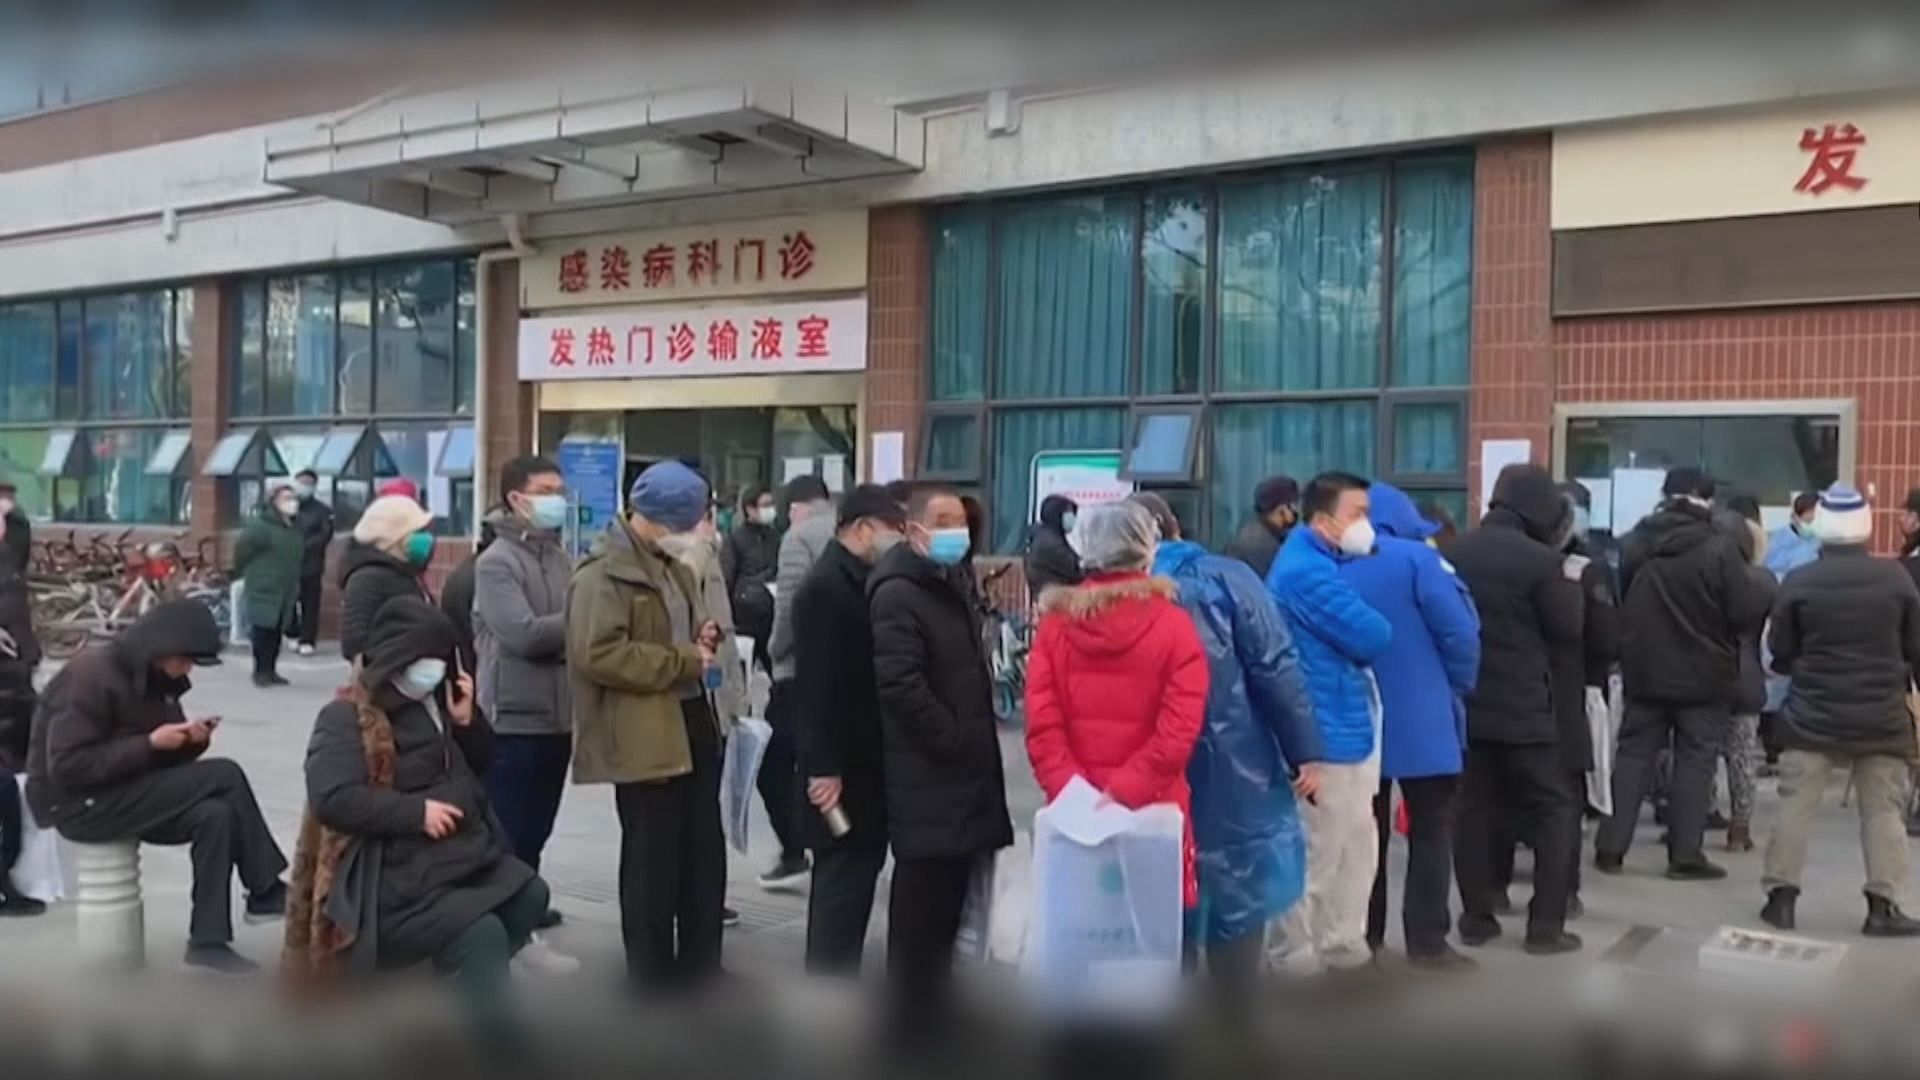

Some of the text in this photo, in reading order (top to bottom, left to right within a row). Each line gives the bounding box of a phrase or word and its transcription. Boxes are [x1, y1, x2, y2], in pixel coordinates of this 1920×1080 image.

[1793, 123, 1868, 196] 发
[557, 230, 816, 294] 感染病科门诊
[549, 314, 831, 367] 发热门诊输液室
